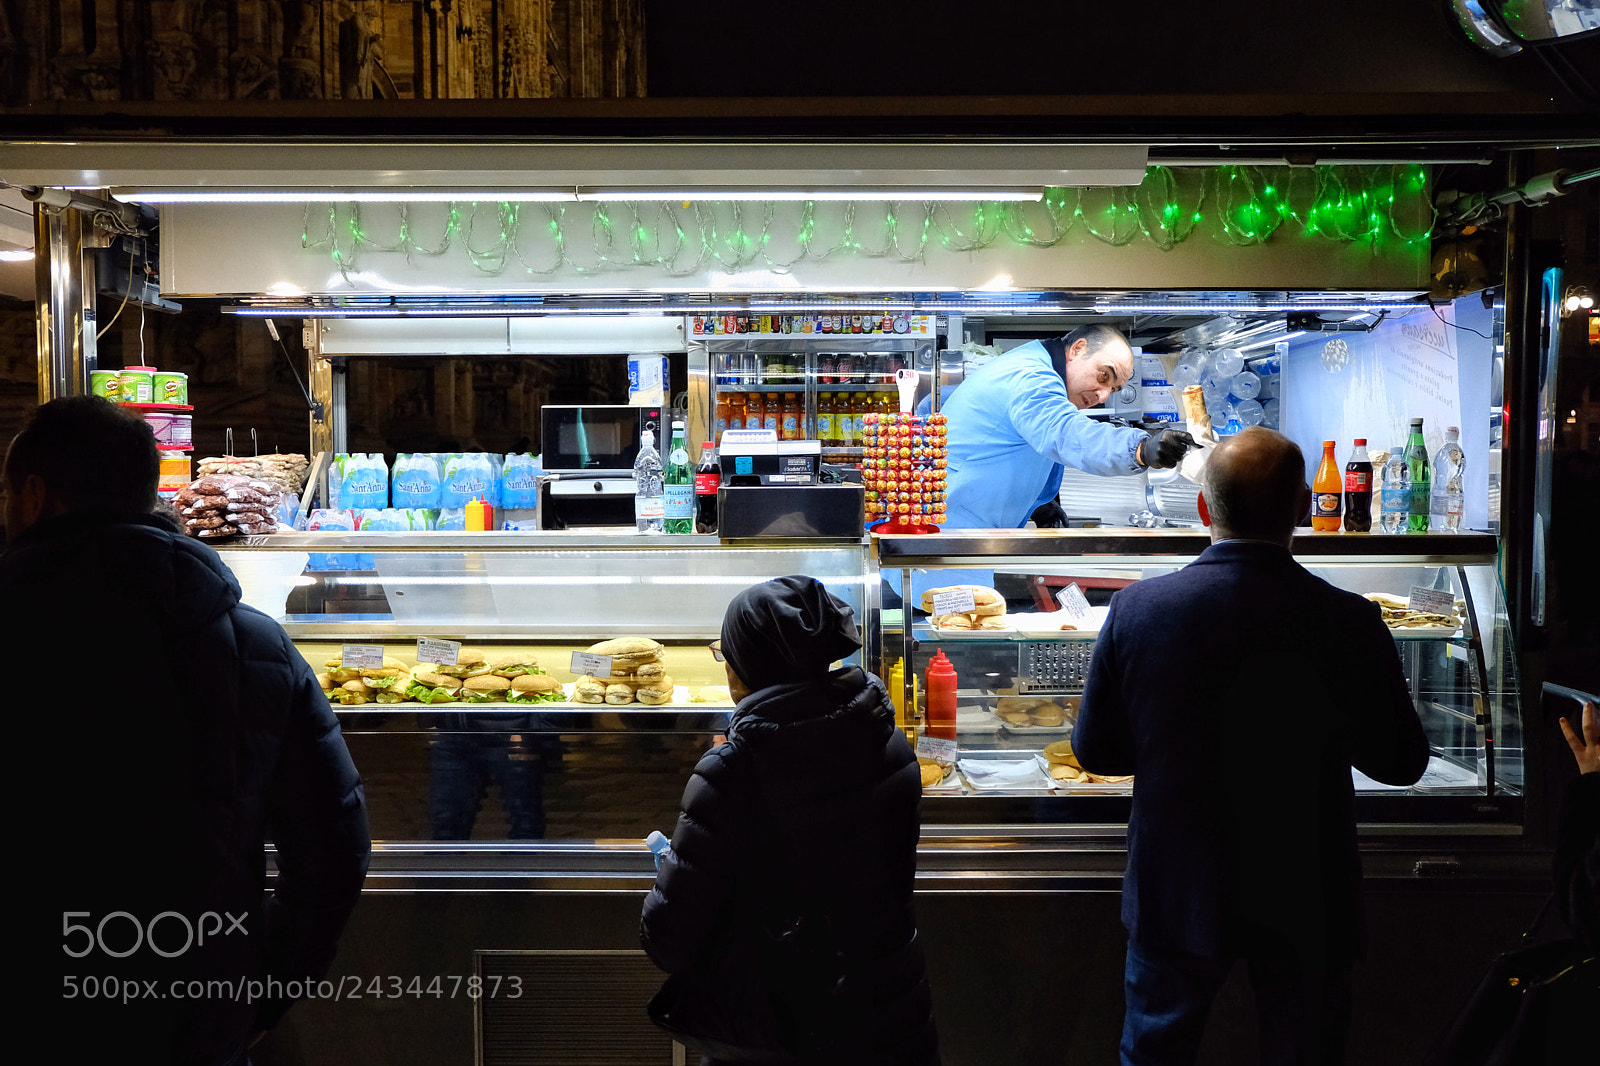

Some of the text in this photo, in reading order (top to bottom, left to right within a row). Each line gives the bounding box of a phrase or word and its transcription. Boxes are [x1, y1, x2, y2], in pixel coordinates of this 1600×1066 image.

[351, 481, 385, 493] Sant'Anna
[398, 481, 432, 493] Sant'Anna
[452, 482, 485, 493] Sant'Anna
[507, 479, 537, 489] Sant'Ann
